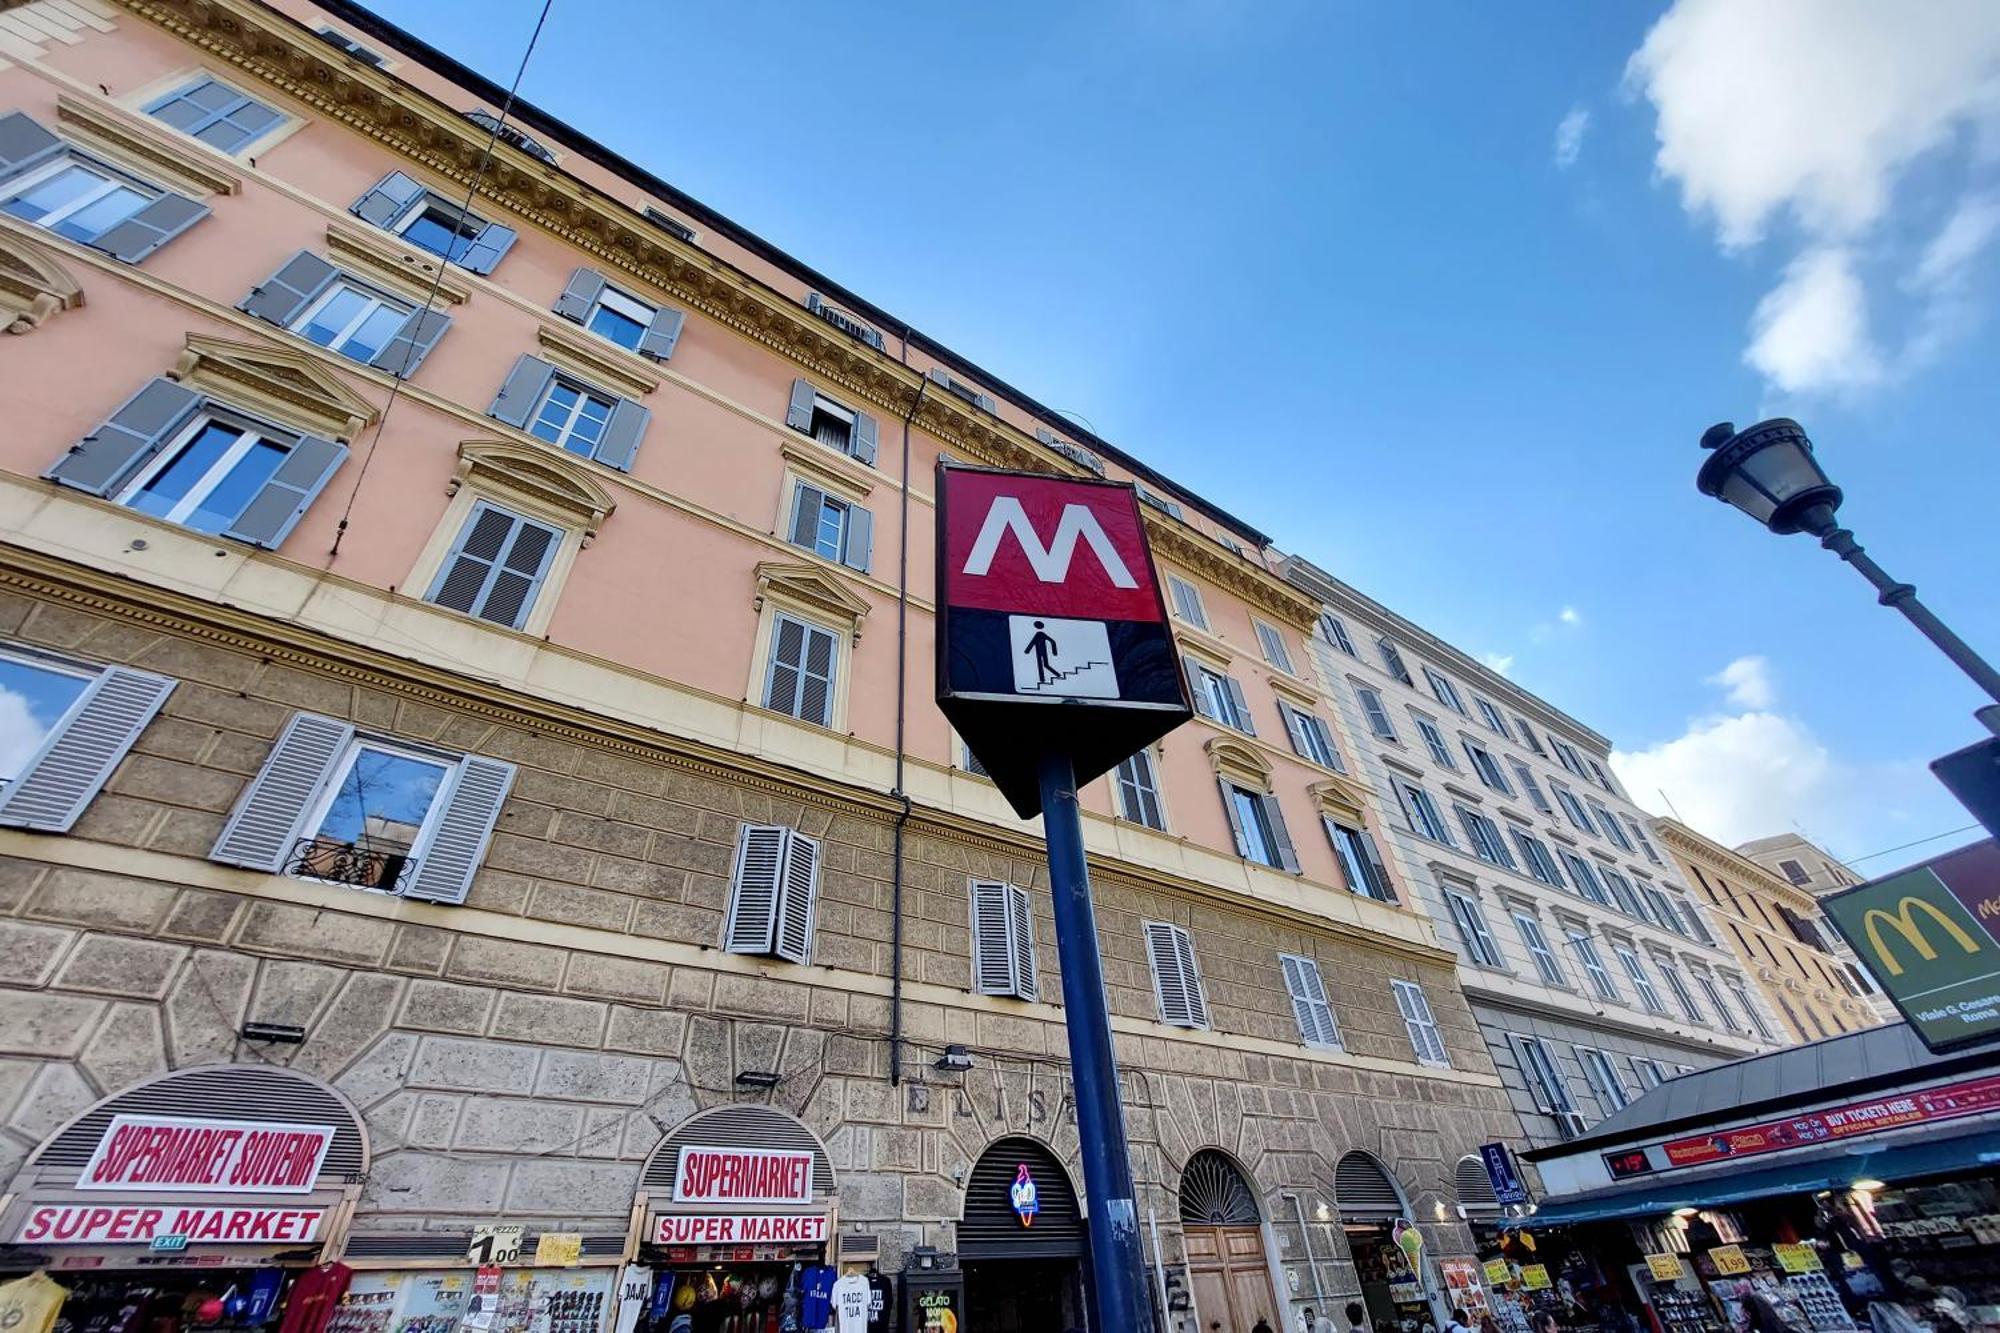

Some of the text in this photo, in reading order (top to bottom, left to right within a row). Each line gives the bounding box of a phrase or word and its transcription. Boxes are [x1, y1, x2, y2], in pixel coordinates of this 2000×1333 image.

[963, 496, 1140, 589] M
[1960, 1008, 1999, 1023] Roma
[1824, 1098, 1918, 1127] BUY TICKETS HERE
[1832, 1111, 1924, 1135] OFFICIAL RETAILER
[92, 1124, 325, 1186] SUPERMARKET SOUVENIR
[682, 1152, 812, 1199] SUPERMARKET
[24, 1208, 321, 1242] SUPER MARKET
[659, 1217, 826, 1242] SUPER MARKET
[154, 1236, 184, 1248] EXIT
[919, 1296, 950, 1307] GELATO
